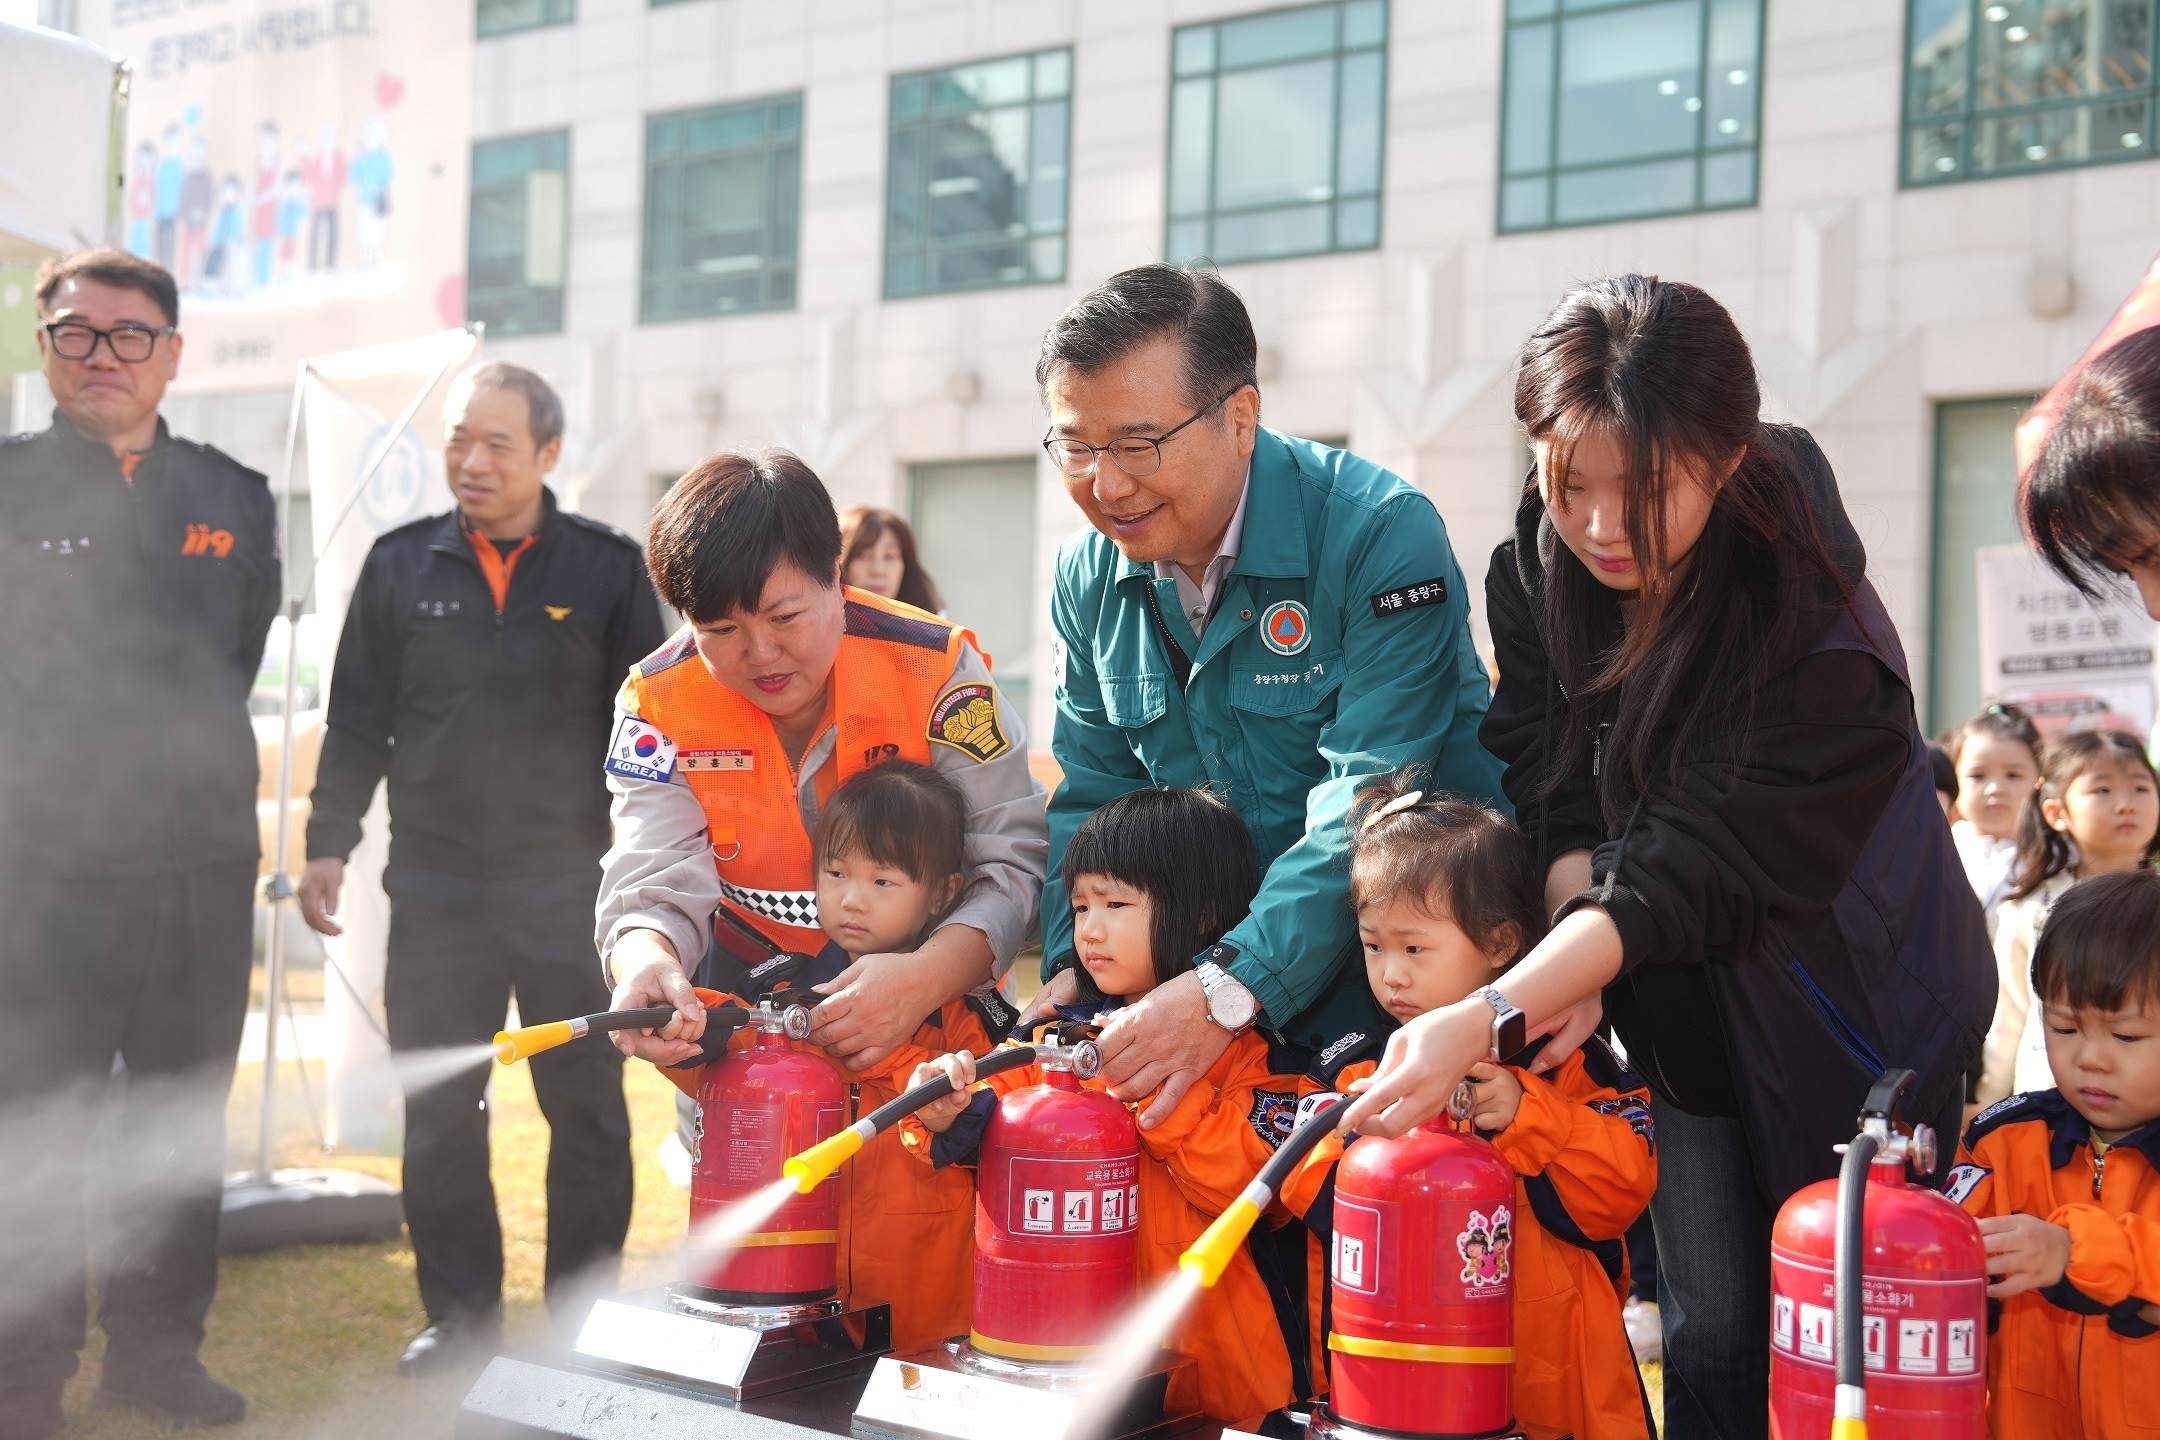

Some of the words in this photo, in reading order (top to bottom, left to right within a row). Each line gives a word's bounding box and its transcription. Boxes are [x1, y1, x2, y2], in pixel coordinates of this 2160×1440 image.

[1379, 592, 1404, 610] 서울
[1407, 583, 1444, 604] 중랑구
[933, 691, 963, 722] VOLUNTEER
[961, 687, 978, 698] FIRE
[614, 760, 660, 781] KOREA
